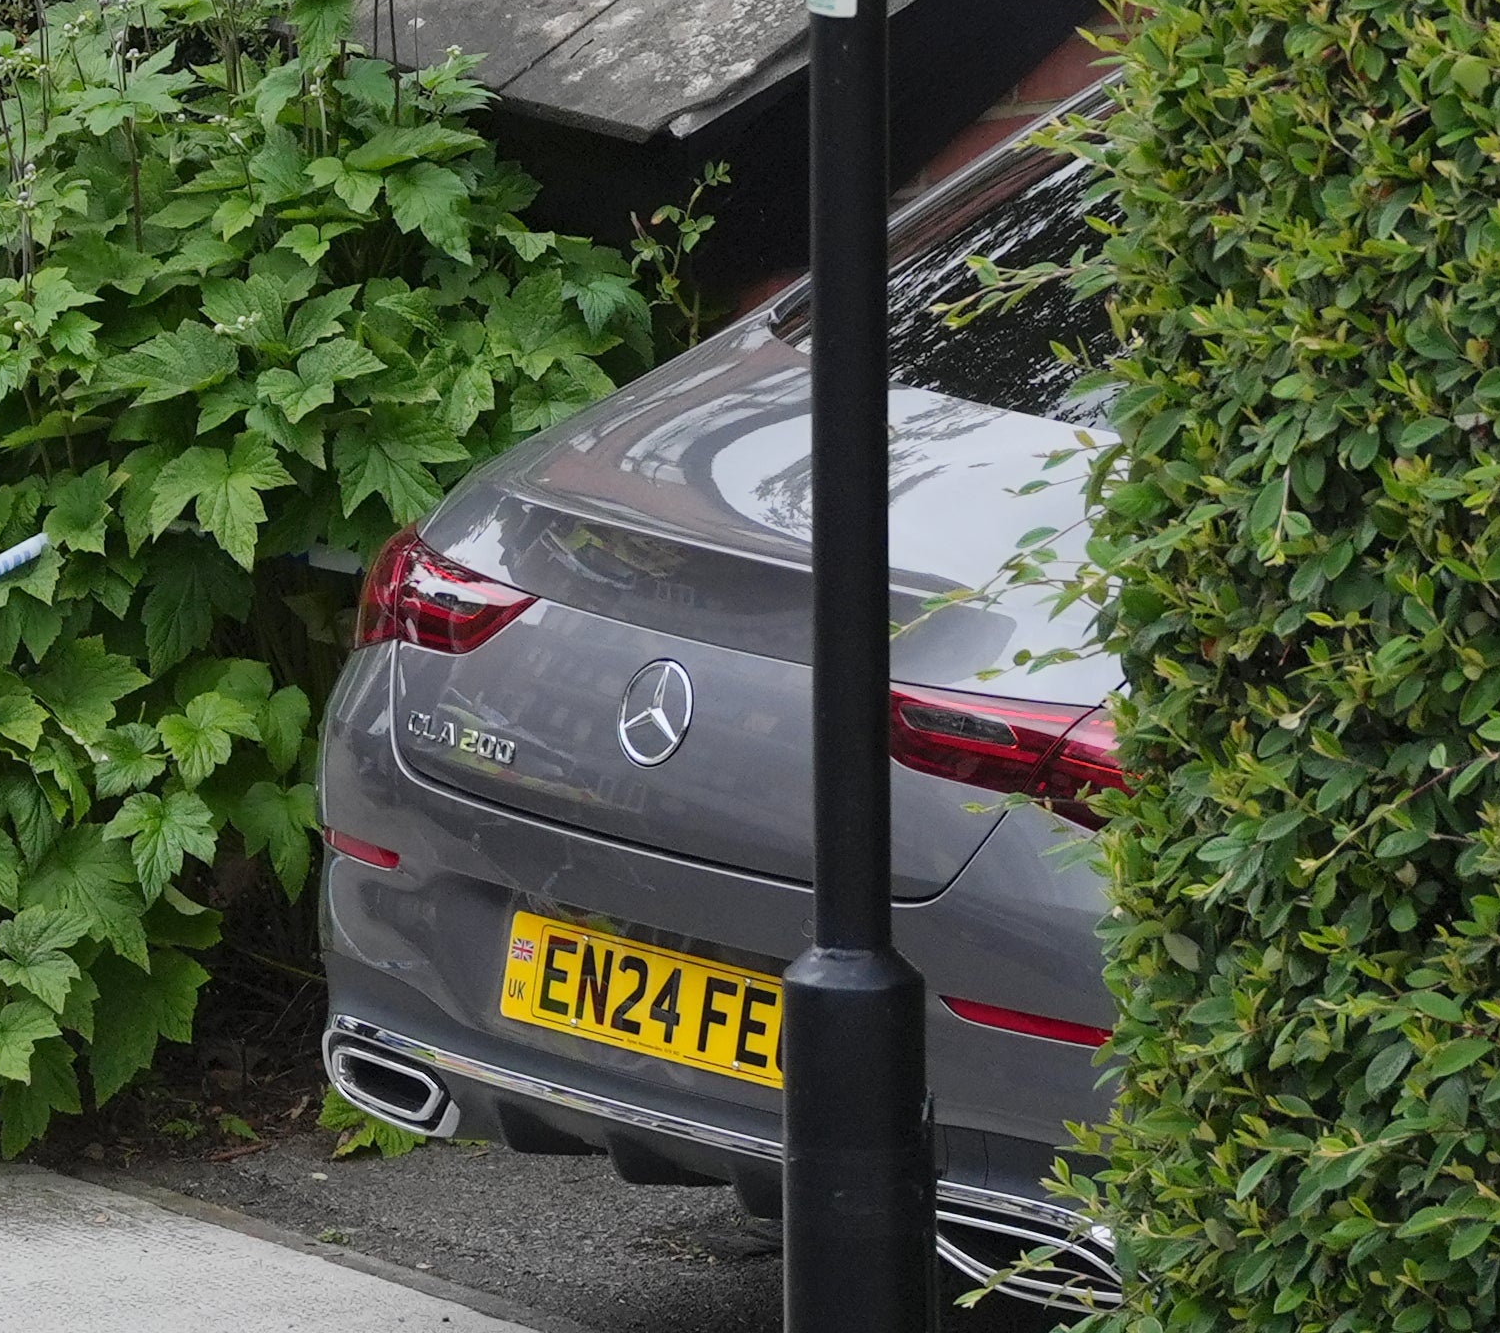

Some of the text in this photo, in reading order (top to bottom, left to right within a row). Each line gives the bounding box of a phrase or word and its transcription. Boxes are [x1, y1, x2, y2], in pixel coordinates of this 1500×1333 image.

[407, 709, 517, 765] CLA 200
[507, 977, 527, 1002] UK
[538, 934, 783, 1073] EN24 FE
